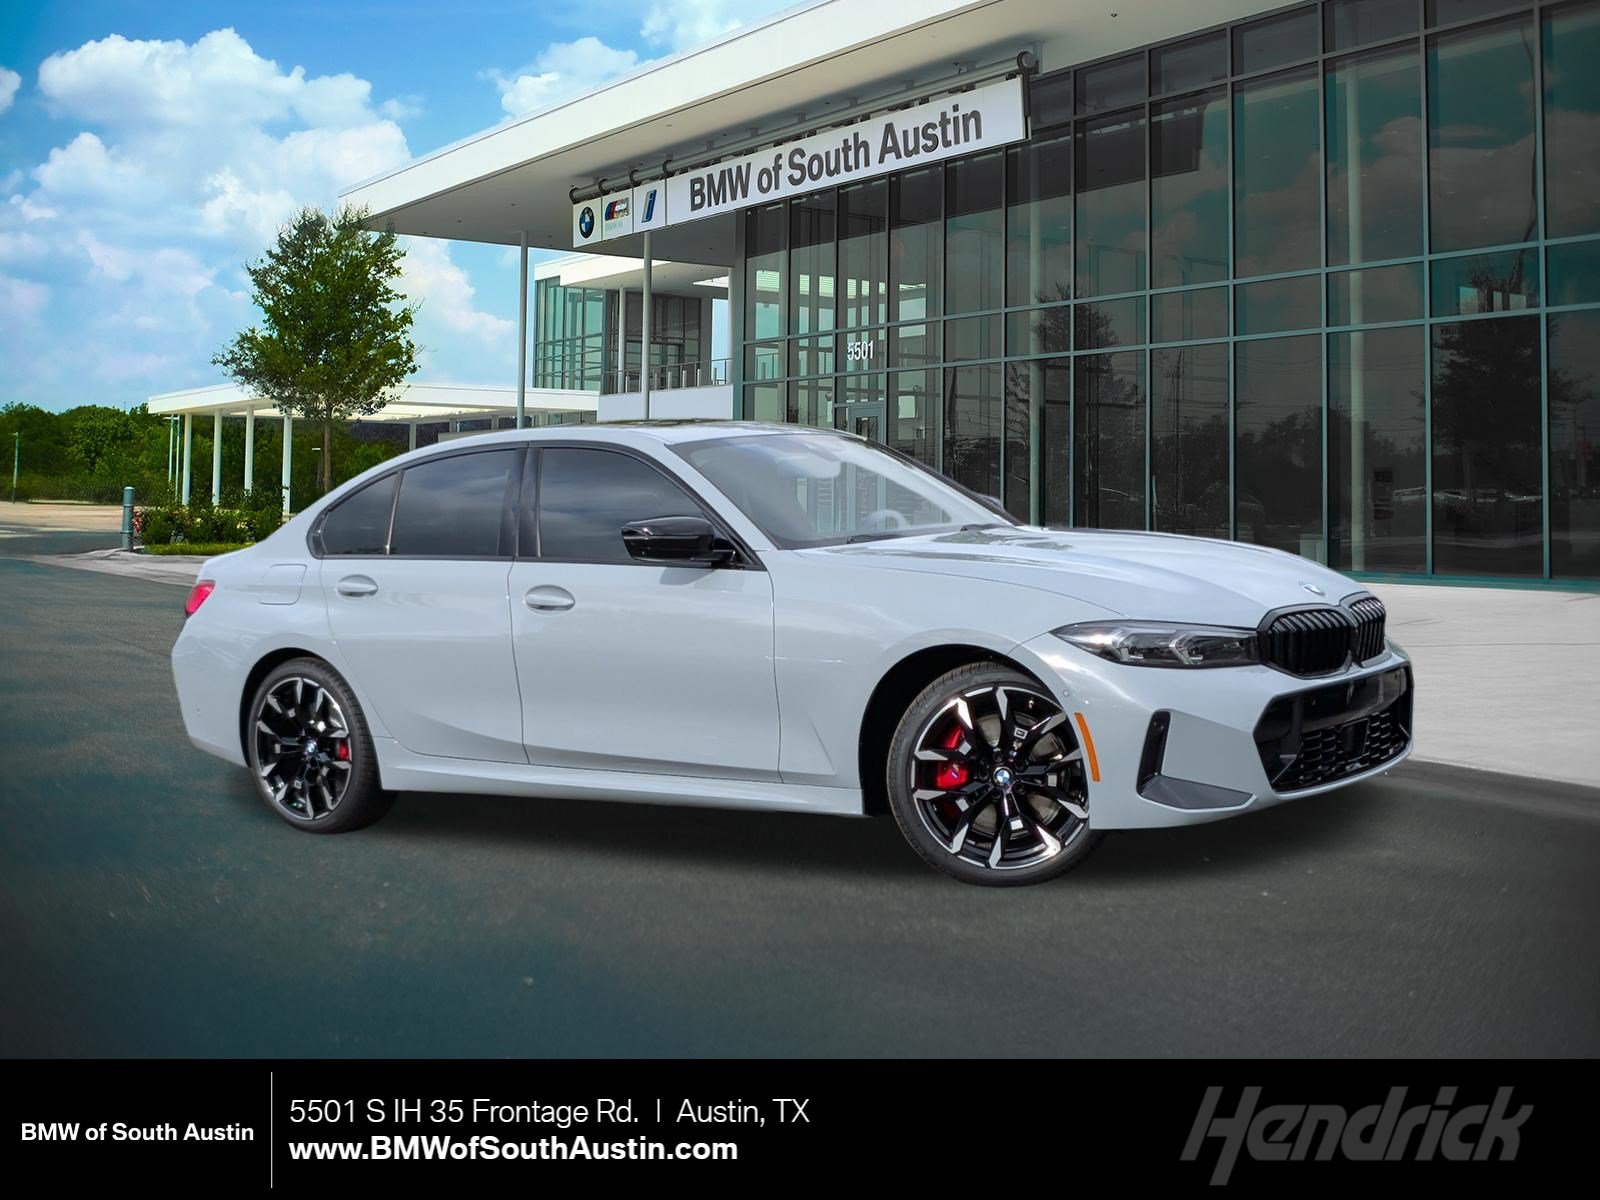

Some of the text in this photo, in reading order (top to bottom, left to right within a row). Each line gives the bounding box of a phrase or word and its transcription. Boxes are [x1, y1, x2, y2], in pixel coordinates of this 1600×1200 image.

[690, 162, 751, 211] BMW
[757, 153, 782, 194] of
[788, 131, 870, 186] South
[878, 104, 982, 164] Austin
[847, 340, 873, 360] 5501
